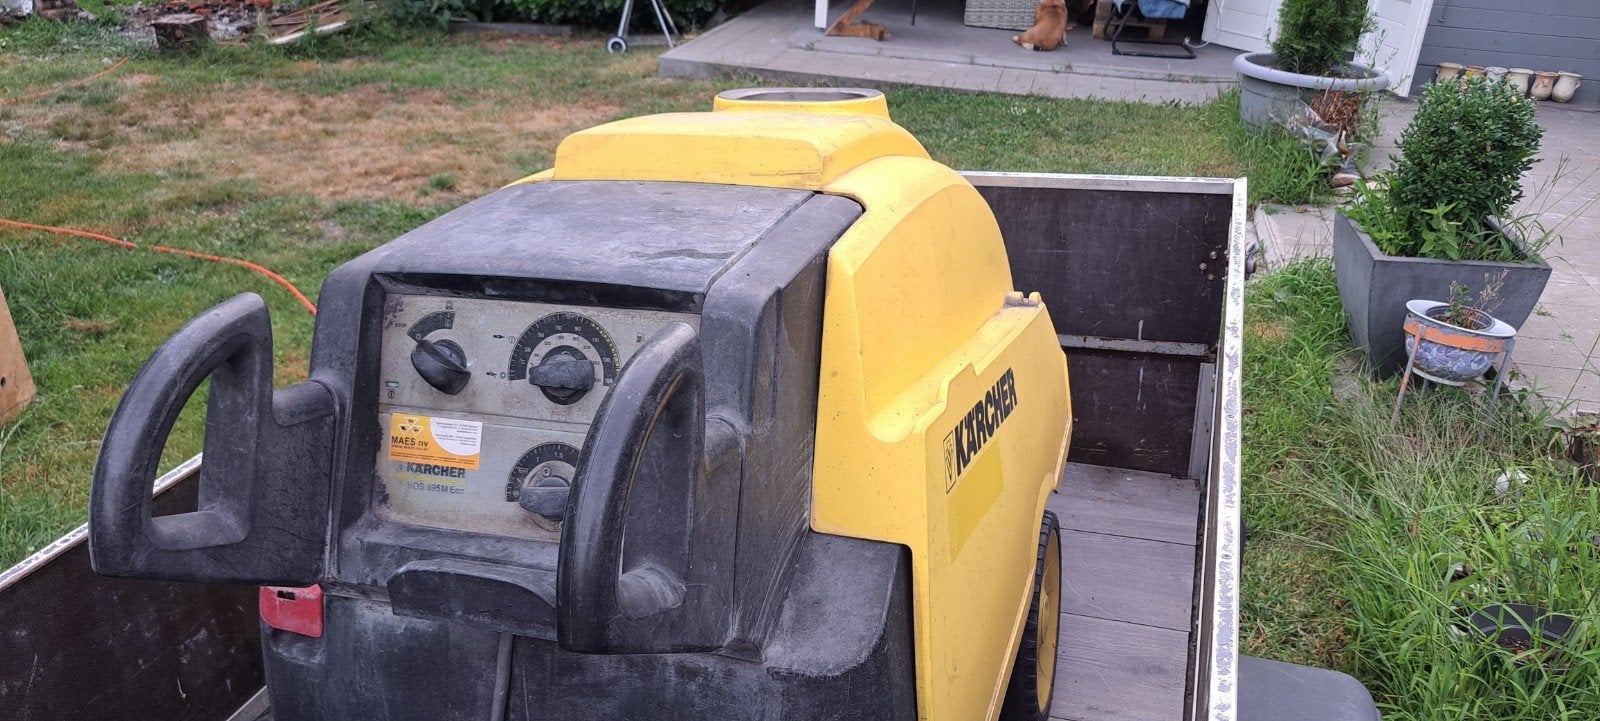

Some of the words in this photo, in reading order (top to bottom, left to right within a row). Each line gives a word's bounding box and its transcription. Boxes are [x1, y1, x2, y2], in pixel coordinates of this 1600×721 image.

[954, 367, 1018, 476] KÄRCHER
[391, 436, 416, 446] MAES
[406, 462, 466, 478] KÄRCHER
[407, 482, 424, 490] HDS
[450, 486, 464, 494] Eco
